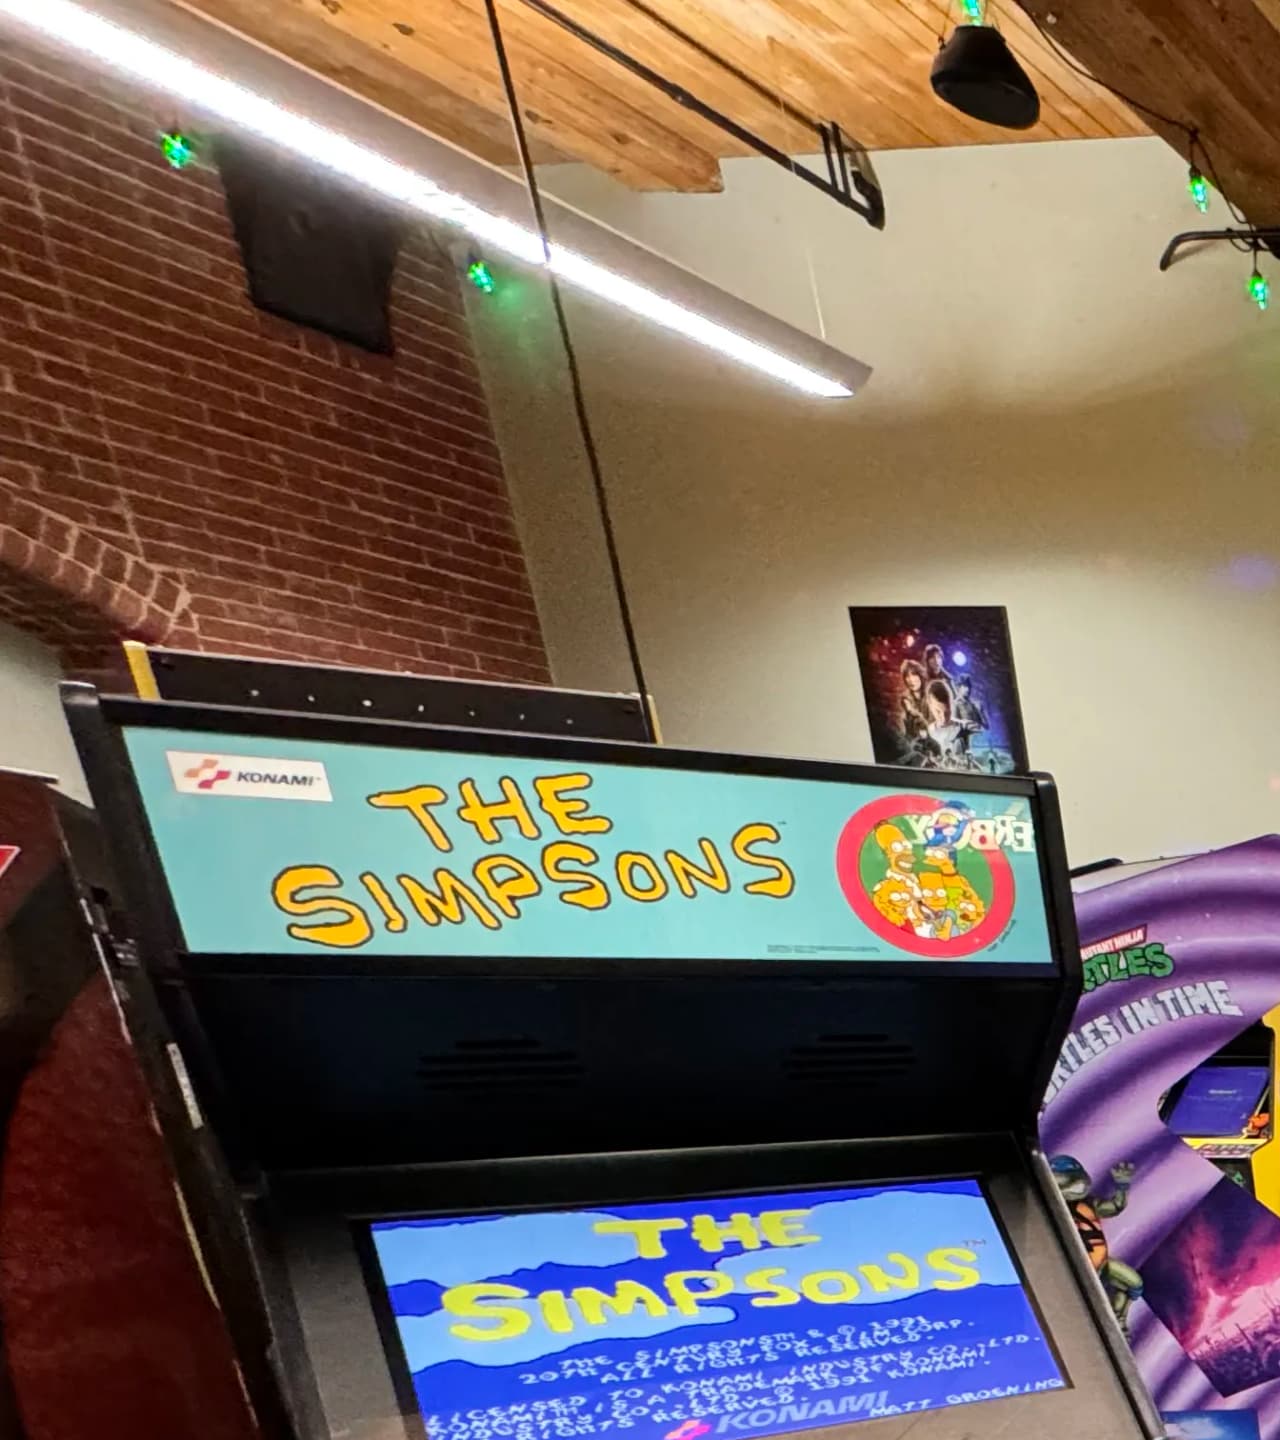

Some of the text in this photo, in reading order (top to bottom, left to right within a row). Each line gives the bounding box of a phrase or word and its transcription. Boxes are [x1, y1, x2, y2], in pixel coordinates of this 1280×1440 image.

[237, 771, 314, 786] KONAMI
[367, 772, 612, 852] THE
[272, 821, 796, 948] SIMPSONS
[1115, 930, 1145, 948] NINJA
[1120, 998, 1158, 1033] IN
[1157, 981, 1243, 1020] TIME
[592, 1209, 821, 1260] THE
[441, 1246, 985, 1343] SIMPSONS
[520, 1368, 598, 1384] 20TH
[616, 1347, 744, 1372] CENTURY
[761, 1339, 808, 1352] FOX
[559, 1354, 613, 1369] THE
[869, 1316, 931, 1329] 1991
[600, 1334, 934, 1384] ALL RIGHTS RESERVED.
[427, 1396, 588, 1426] LICENSED
[608, 1388, 644, 1400] TO
[660, 1371, 763, 1394] KONAMI
[790, 1351, 913, 1375] INDUSTRY
[596, 1400, 629, 1413] IS
[648, 1395, 666, 1405] A
[687, 1371, 848, 1399] TRADEMARK
[853, 1364, 883, 1375] OF
[900, 1344, 986, 1368] KONAMI
[808, 1374, 873, 1391] 1991
[869, 1377, 1065, 1417] MATT GROENING
[652, 1395, 808, 1424] RESERVED.
[716, 1390, 889, 1433] KONAMI
